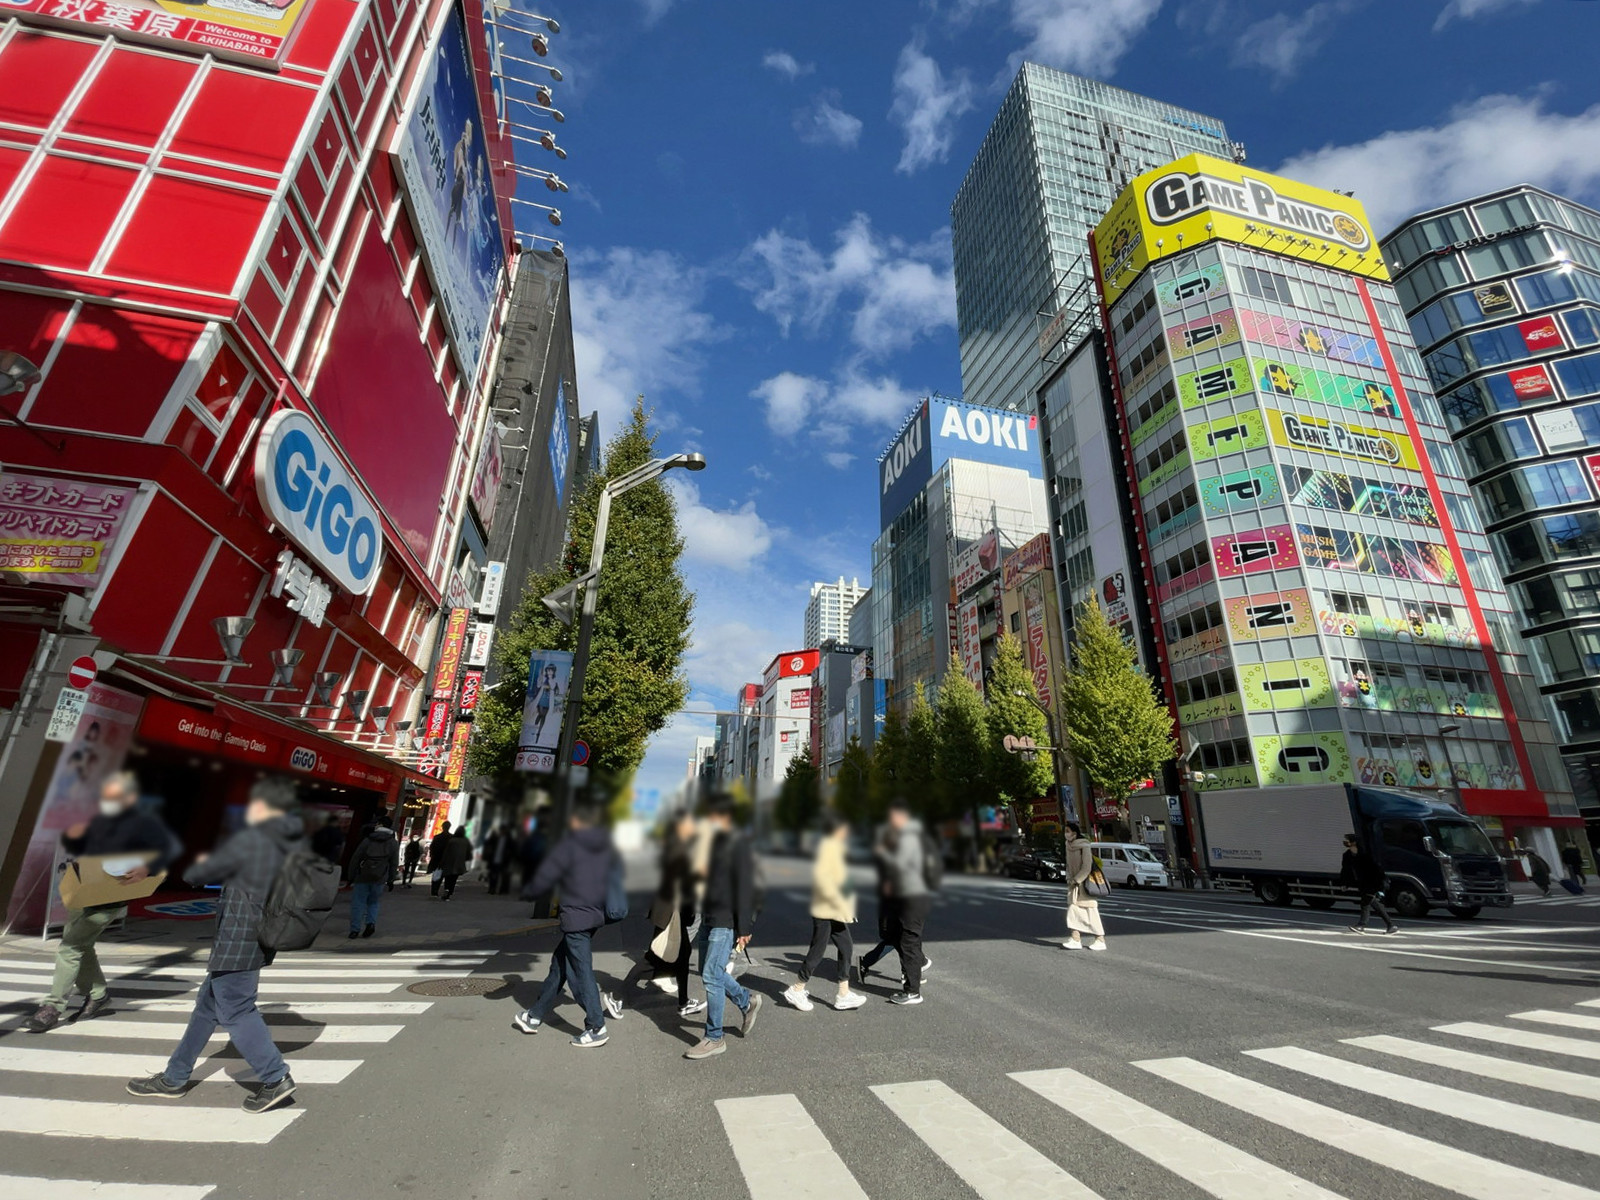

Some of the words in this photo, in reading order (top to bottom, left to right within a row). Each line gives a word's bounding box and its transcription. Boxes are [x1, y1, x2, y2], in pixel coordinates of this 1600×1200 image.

[49, 0, 186, 38] 秋葉原
[205, 24, 257, 41] Welcome
[260, 35, 272, 44] to
[198, 35, 265, 55] AKIHABARA
[1152, 173, 1248, 215] GAME
[1246, 179, 1335, 236] PANIC
[940, 405, 1028, 451] AOKI
[1285, 415, 1332, 446] GAME
[883, 416, 923, 495] AOKI
[3, 482, 122, 511] ギフトカード
[274, 429, 376, 580] GiGO
[1395, 493, 1430, 506] DANCE
[1398, 504, 1427, 517] GAME
[1300, 533, 1336, 546] MUSIC
[1303, 546, 1338, 560] GAME
[475, 630, 488, 657] GPS
[433, 689, 452, 699] 2F
[1185, 703, 1236, 722] クレーンゲーム
[178, 719, 193, 734] Get
[194, 723, 210, 740] into
[210, 728, 222, 742] the
[224, 732, 250, 751] Gaming
[250, 739, 267, 753] Oasis
[291, 750, 316, 770] GiGO
[1169, 797, 1177, 808] P
